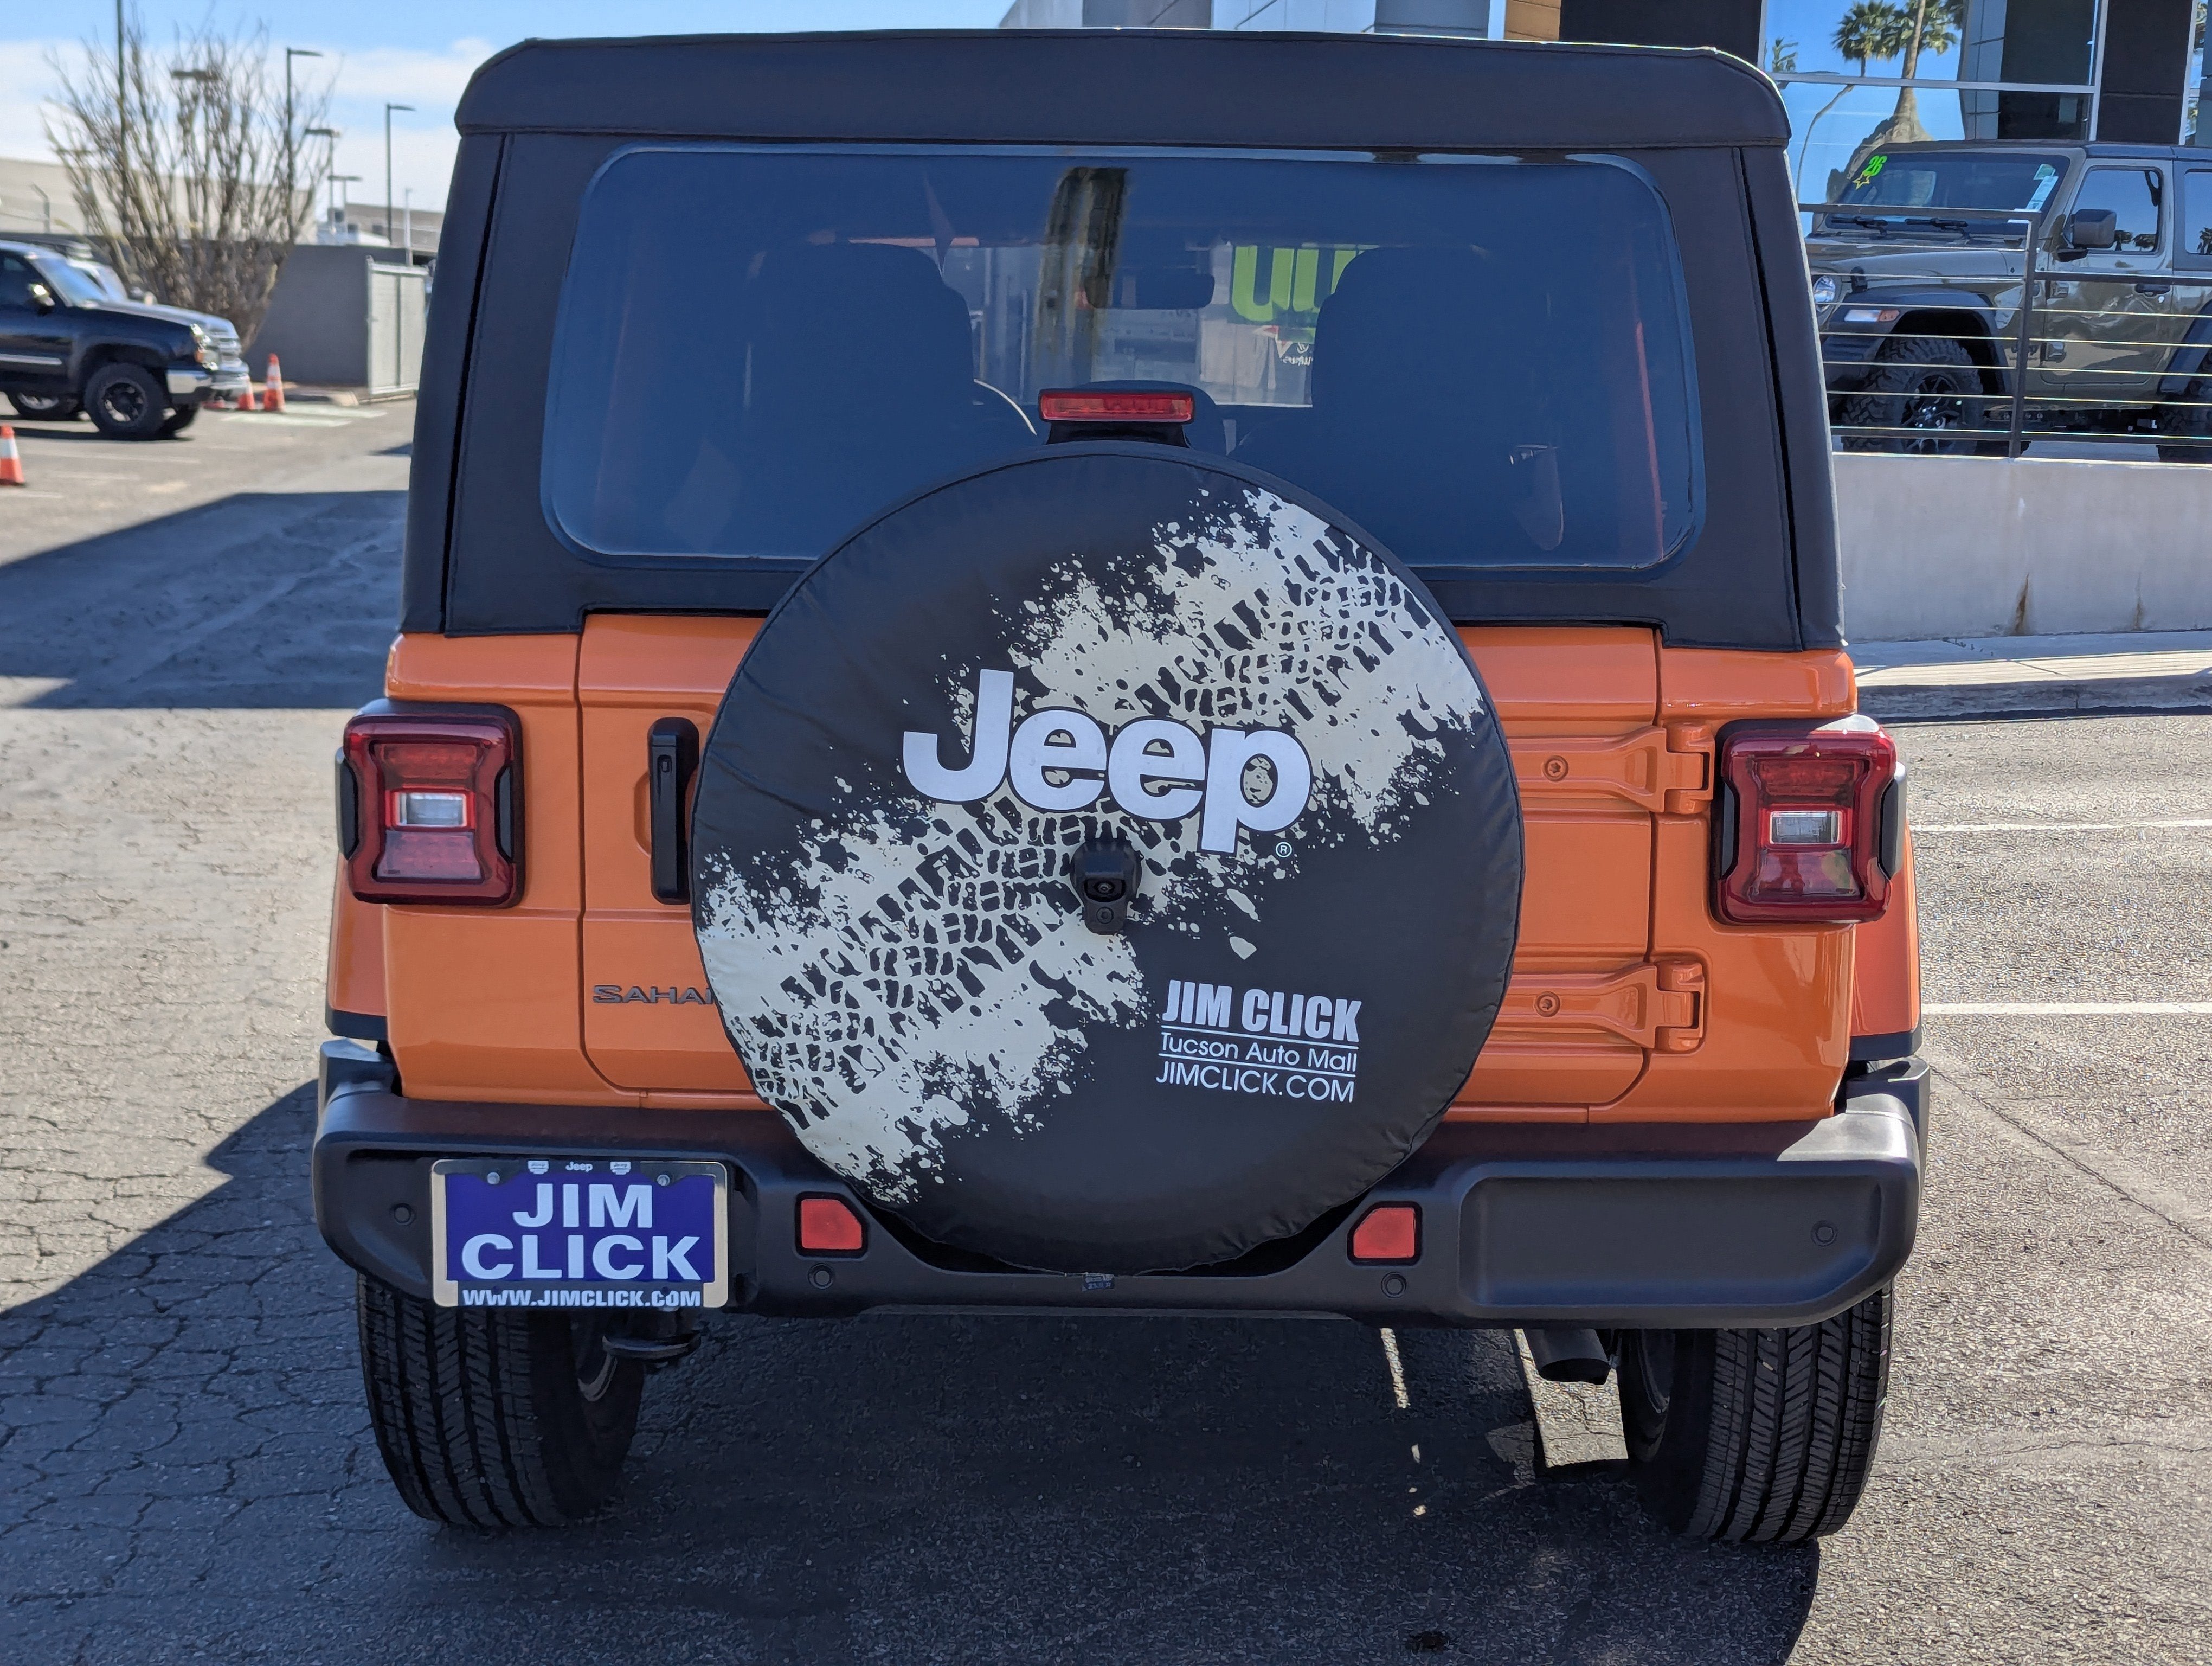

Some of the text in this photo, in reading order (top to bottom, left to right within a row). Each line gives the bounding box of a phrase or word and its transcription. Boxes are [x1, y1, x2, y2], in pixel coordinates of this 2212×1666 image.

[1862, 155, 1888, 177] 26
[903, 669, 1311, 853] Jeep
[1162, 979, 1362, 1043] JIM CLICK
[1161, 1031, 1358, 1072] Tucson Auto Mall
[1156, 1061, 1354, 1103] JIMCLICK.COM
[565, 1161, 593, 1172] Jeep
[512, 1183, 652, 1228] JIM
[461, 1234, 702, 1280] CLICK
[462, 1289, 700, 1308] WWW.JIMCLICK.COM
